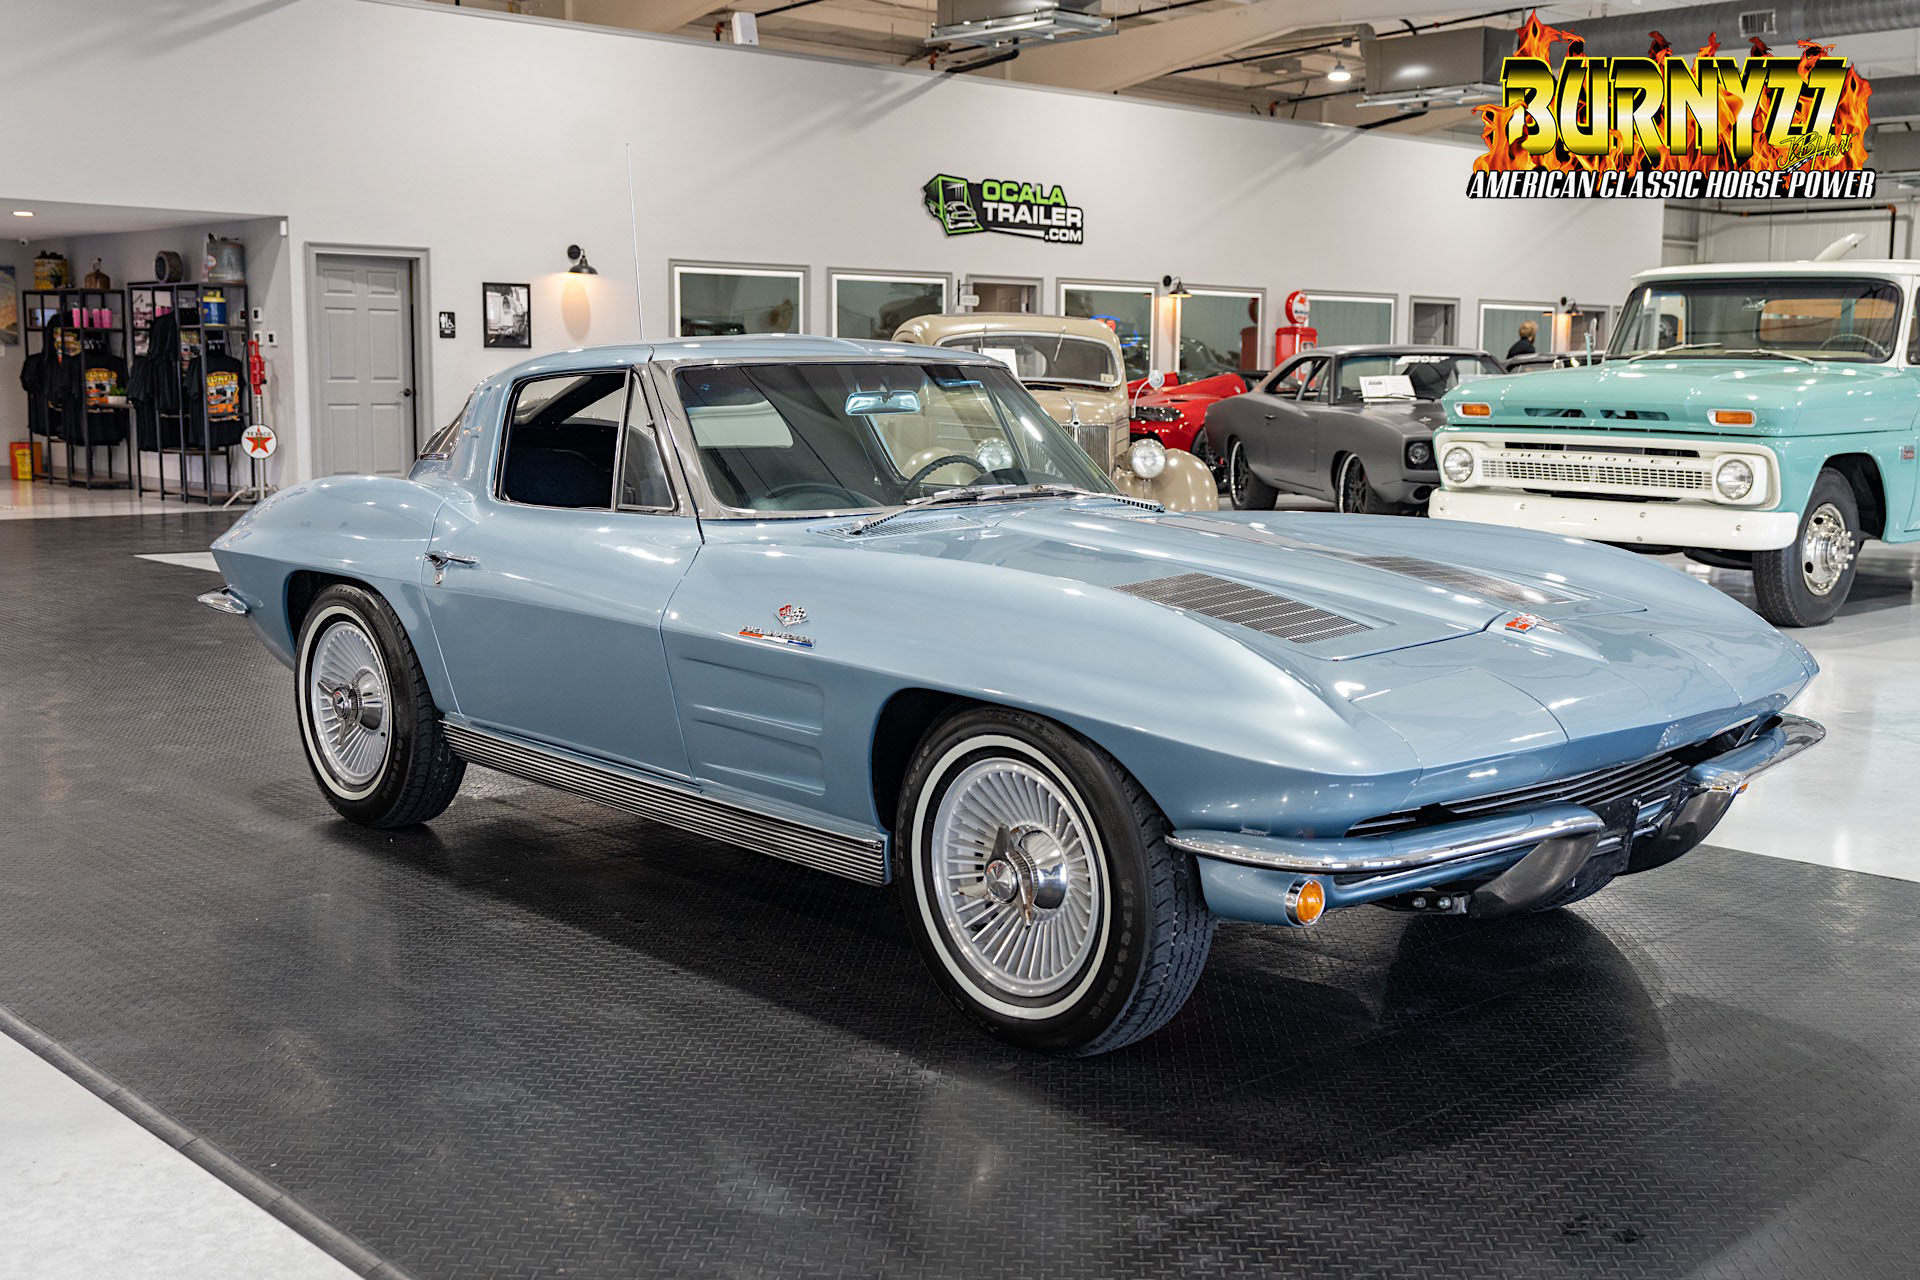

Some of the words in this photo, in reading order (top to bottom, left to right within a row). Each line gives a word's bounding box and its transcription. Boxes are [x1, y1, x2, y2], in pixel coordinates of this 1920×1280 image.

[982, 180, 1067, 206] OCALA
[982, 202, 1083, 228] TRAILER
[1045, 228, 1083, 242] .COM
[1500, 453, 1685, 466] CHEVROLET
